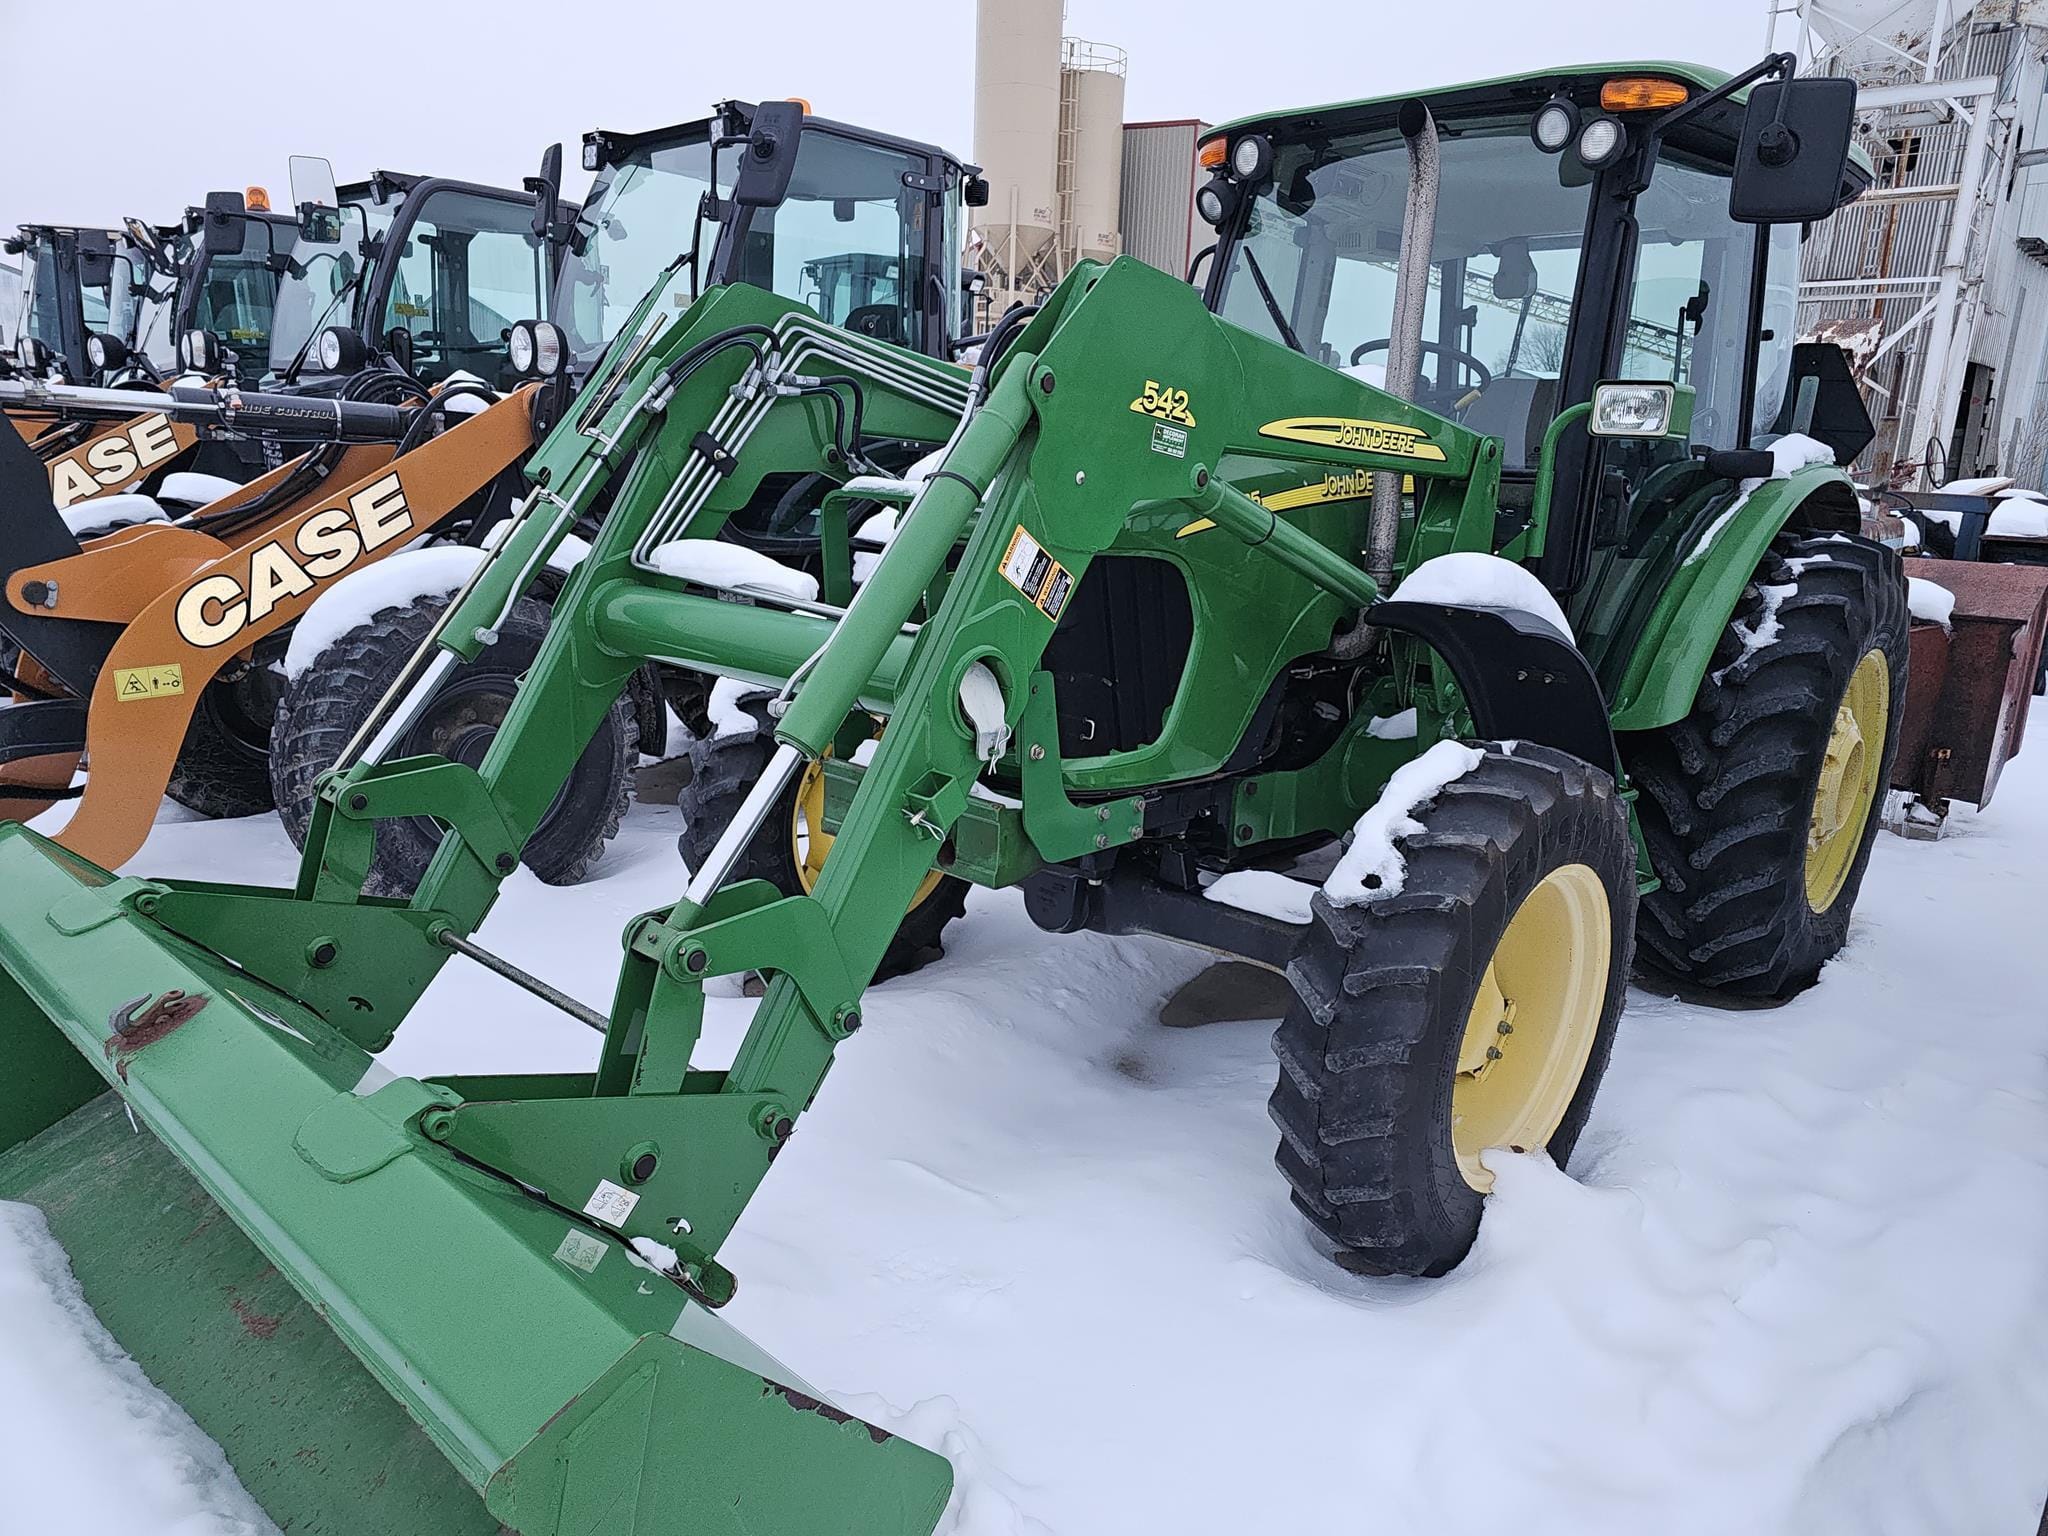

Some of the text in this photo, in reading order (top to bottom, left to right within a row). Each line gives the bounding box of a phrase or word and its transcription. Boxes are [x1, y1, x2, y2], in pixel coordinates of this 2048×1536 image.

[275, 407, 337, 421] CONTROL
[1142, 379, 1188, 422] 542
[1335, 421, 1416, 453] JOHN DEERE
[52, 413, 179, 510] ASE
[1321, 473, 1356, 497] JOHN
[175, 470, 414, 649] CASE
[1006, 531, 1021, 562] WARNING
[1044, 567, 1058, 596] WARNING
